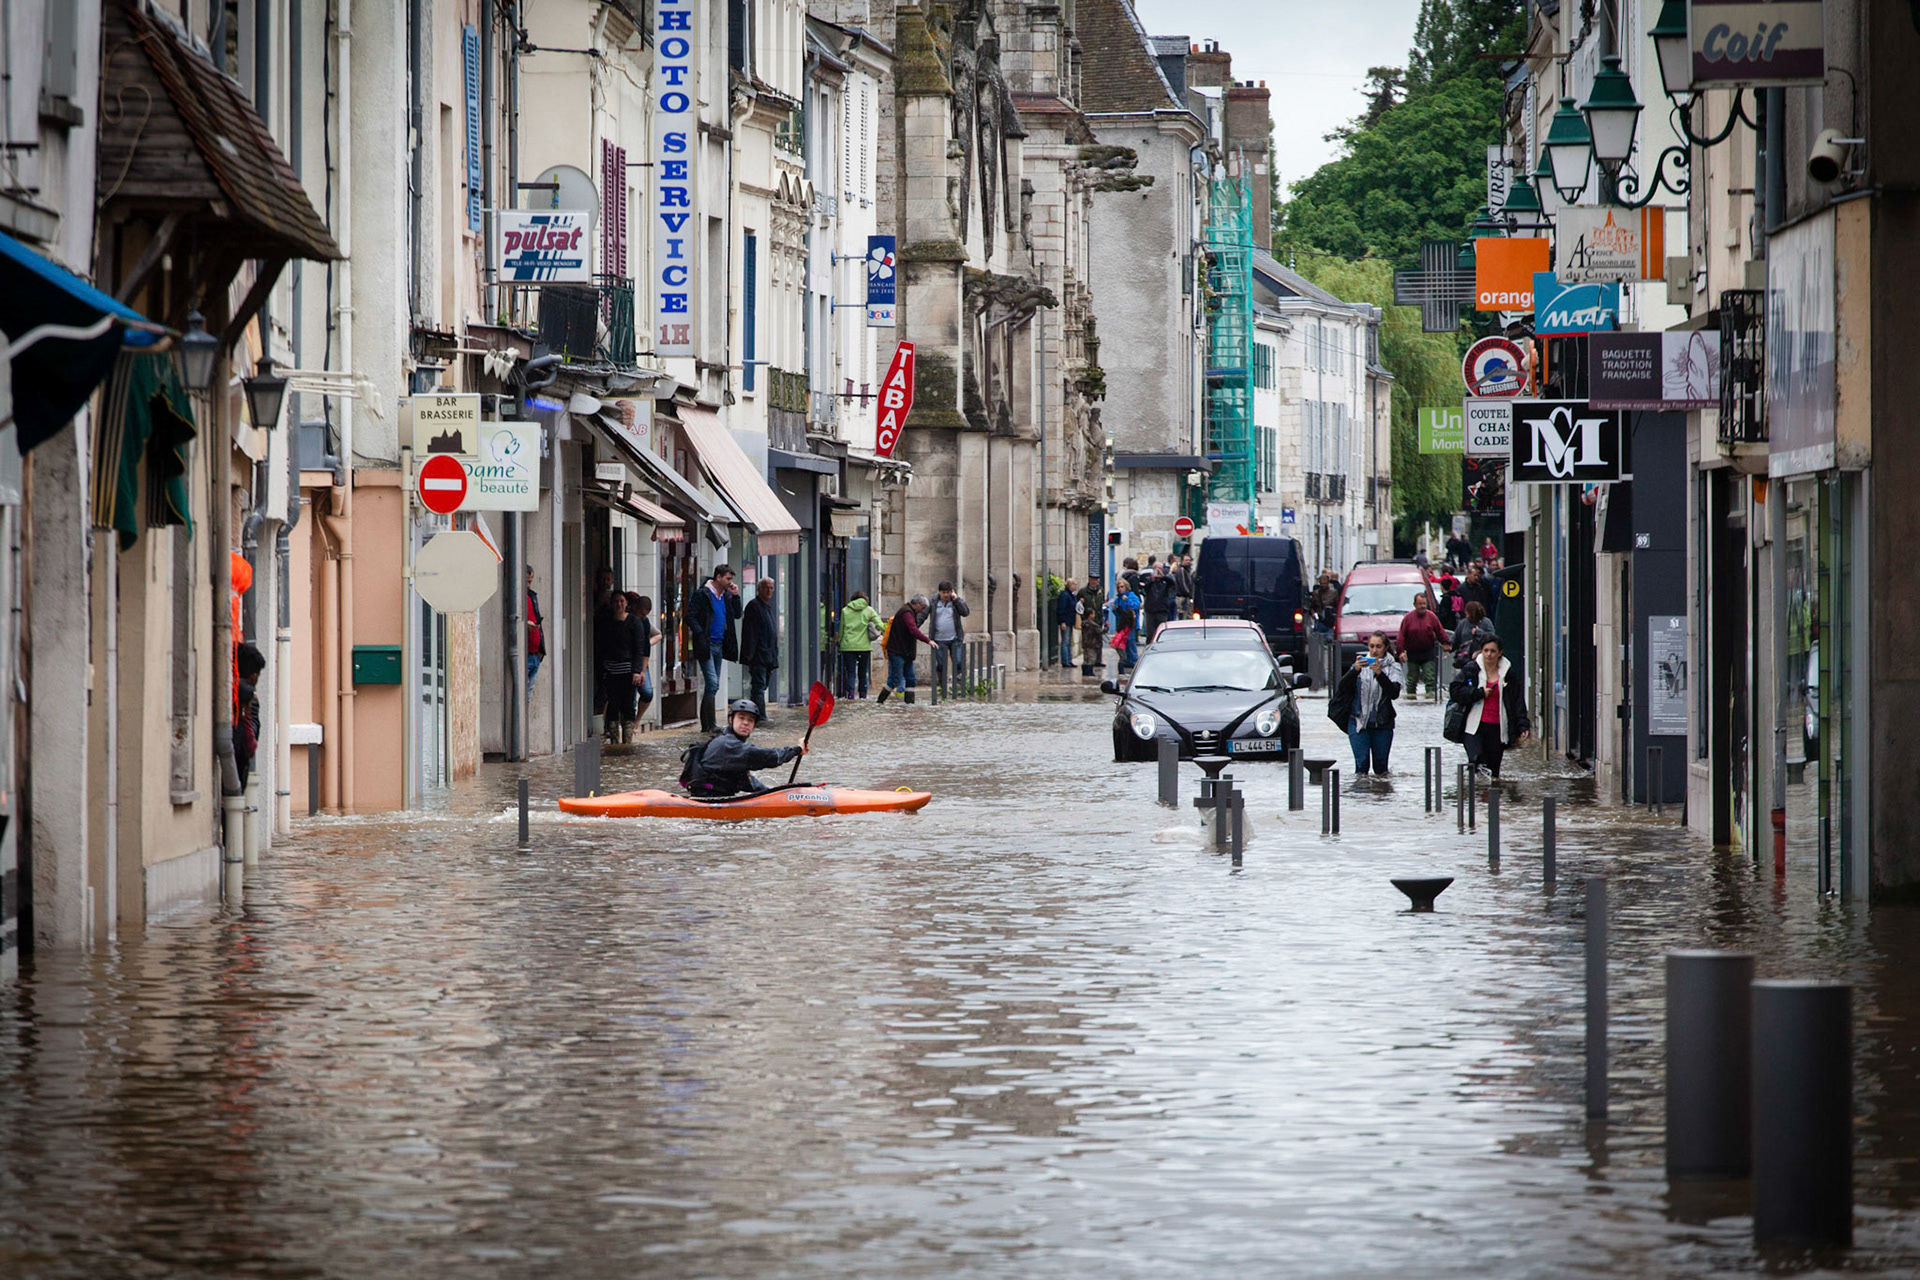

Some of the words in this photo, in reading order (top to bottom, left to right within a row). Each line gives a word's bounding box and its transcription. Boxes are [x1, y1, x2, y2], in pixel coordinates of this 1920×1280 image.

[1702, 21, 1788, 63] Coif
[659, 0, 690, 113] HOTO
[660, 132, 690, 313] SERVICE
[504, 225, 583, 255] pulsat
[1480, 292, 1534, 307] orang
[1543, 307, 1612, 328] MAAF
[659, 324, 690, 345] 1H
[1602, 349, 1652, 359] BAGUETTE
[1602, 360, 1652, 370] TRADITION
[1602, 370, 1652, 381] FRANÇAISE
[436, 397, 457, 407] BAR
[879, 348, 912, 449] TABAC
[420, 410, 474, 420] BRASSERIE
[1470, 410, 1509, 419] COUTEL
[1432, 439, 1465, 450] Mont
[1474, 436, 1509, 446] CADE
[480, 477, 529, 494] beauté
[1637, 535, 1649, 547] 89
[1507, 583, 1516, 596] P
